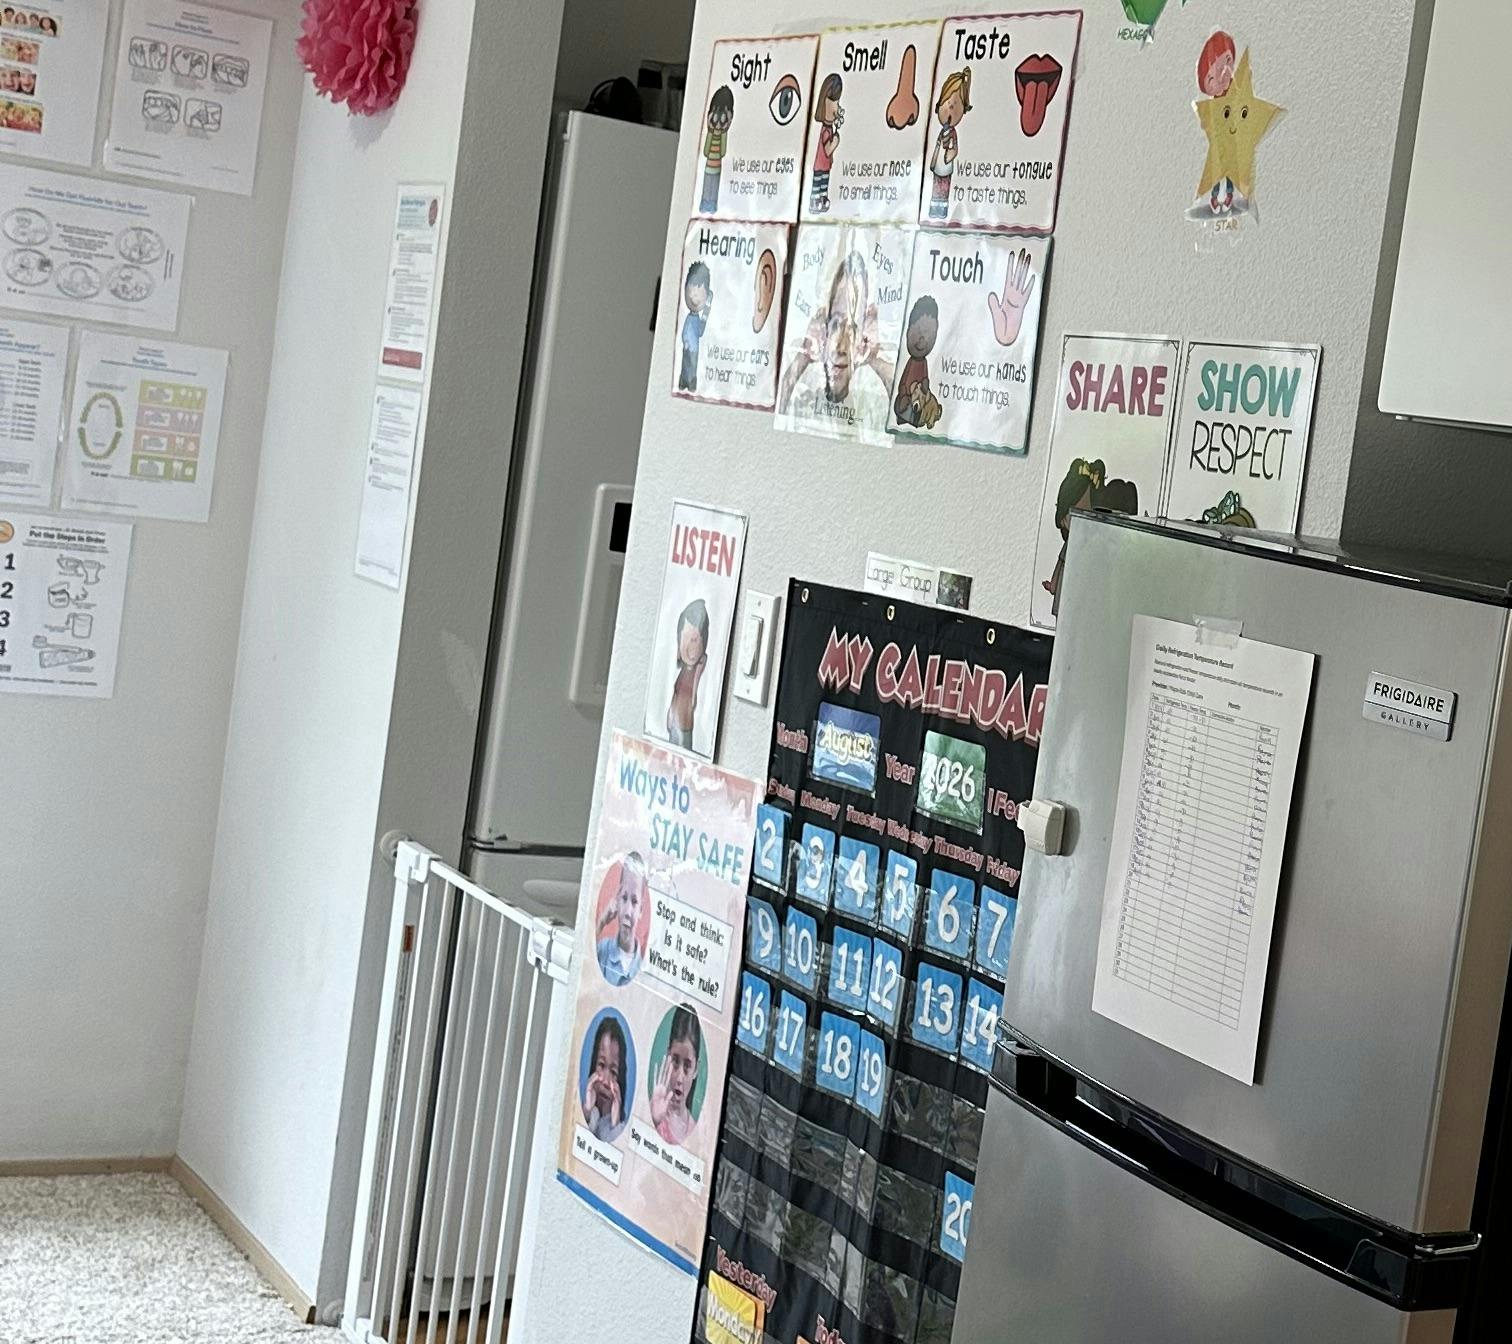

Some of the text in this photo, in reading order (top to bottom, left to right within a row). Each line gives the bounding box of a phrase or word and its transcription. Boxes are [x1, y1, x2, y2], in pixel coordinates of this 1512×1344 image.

[843, 39, 888, 72] Smell
[955, 26, 1010, 60] Taste
[731, 53, 771, 89] Sight
[957, 160, 1052, 180] We use our tongue
[953, 185, 1027, 209] to taste things.
[1215, 219, 1238, 232] STAR
[700, 229, 755, 265] Hearing
[873, 242, 894, 274] Eyes
[930, 249, 984, 284] Touch
[877, 283, 903, 305] Mind
[941, 356, 1026, 383] We use our hands
[938, 381, 949, 398] to
[952, 383, 979, 403] touch
[1066, 358, 1169, 418] SHARE
[1197, 358, 1301, 420] SHOW
[1189, 420, 1294, 482] RESPECT
[29, 530, 105, 544] Put the Steps in Order
[670, 522, 736, 578] LISTEN
[5, 553, 15, 570] 1
[1, 582, 13, 599] 2
[867, 561, 932, 601] Large Group
[818, 625, 873, 695] MY
[1372, 681, 1445, 714] FRIGIDAIRE
[1380, 710, 1431, 732] GALLERY
[820, 721, 874, 765] August
[619, 757, 690, 815] Ways to
[885, 753, 916, 786] Year
[650, 812, 745, 887] STAY SAFE
[761, 818, 1008, 959] 2 3 4 6 7
[656, 900, 676, 925] Stop
[680, 914, 697, 932] and
[676, 934, 682, 952] it
[685, 944, 708, 964] safe?
[649, 948, 719, 998] What's the rule?
[757, 907, 998, 1056] 9 10 11 12 13 14
[741, 985, 883, 1097] 16 17 18 19
[716, 1244, 777, 1313] Yesterday
